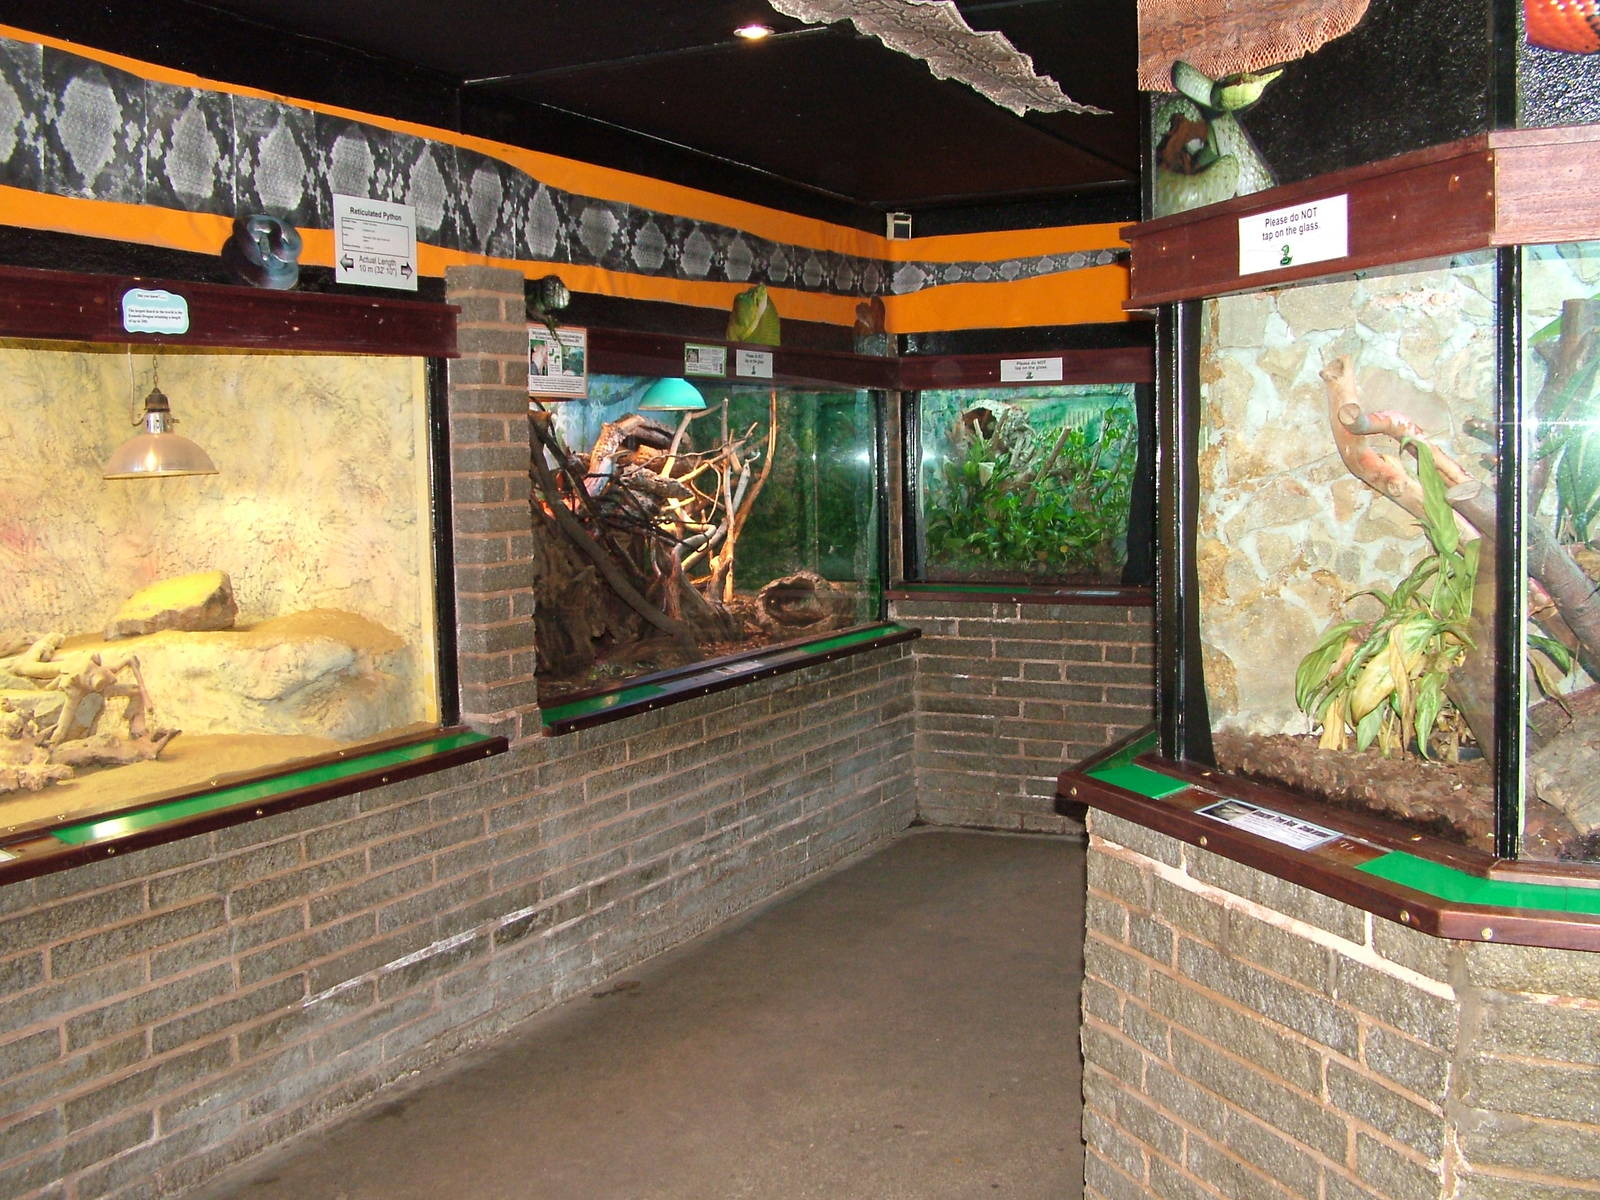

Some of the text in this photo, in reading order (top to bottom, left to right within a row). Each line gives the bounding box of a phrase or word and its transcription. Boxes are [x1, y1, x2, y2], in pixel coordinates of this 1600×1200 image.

[349, 206, 402, 221] Reticulated Python
[1264, 206, 1318, 228] Please do NOT
[1262, 231, 1274, 241] tap
[1275, 229, 1284, 238] on
[1285, 226, 1297, 236] the
[359, 255, 397, 267] Actual Length
